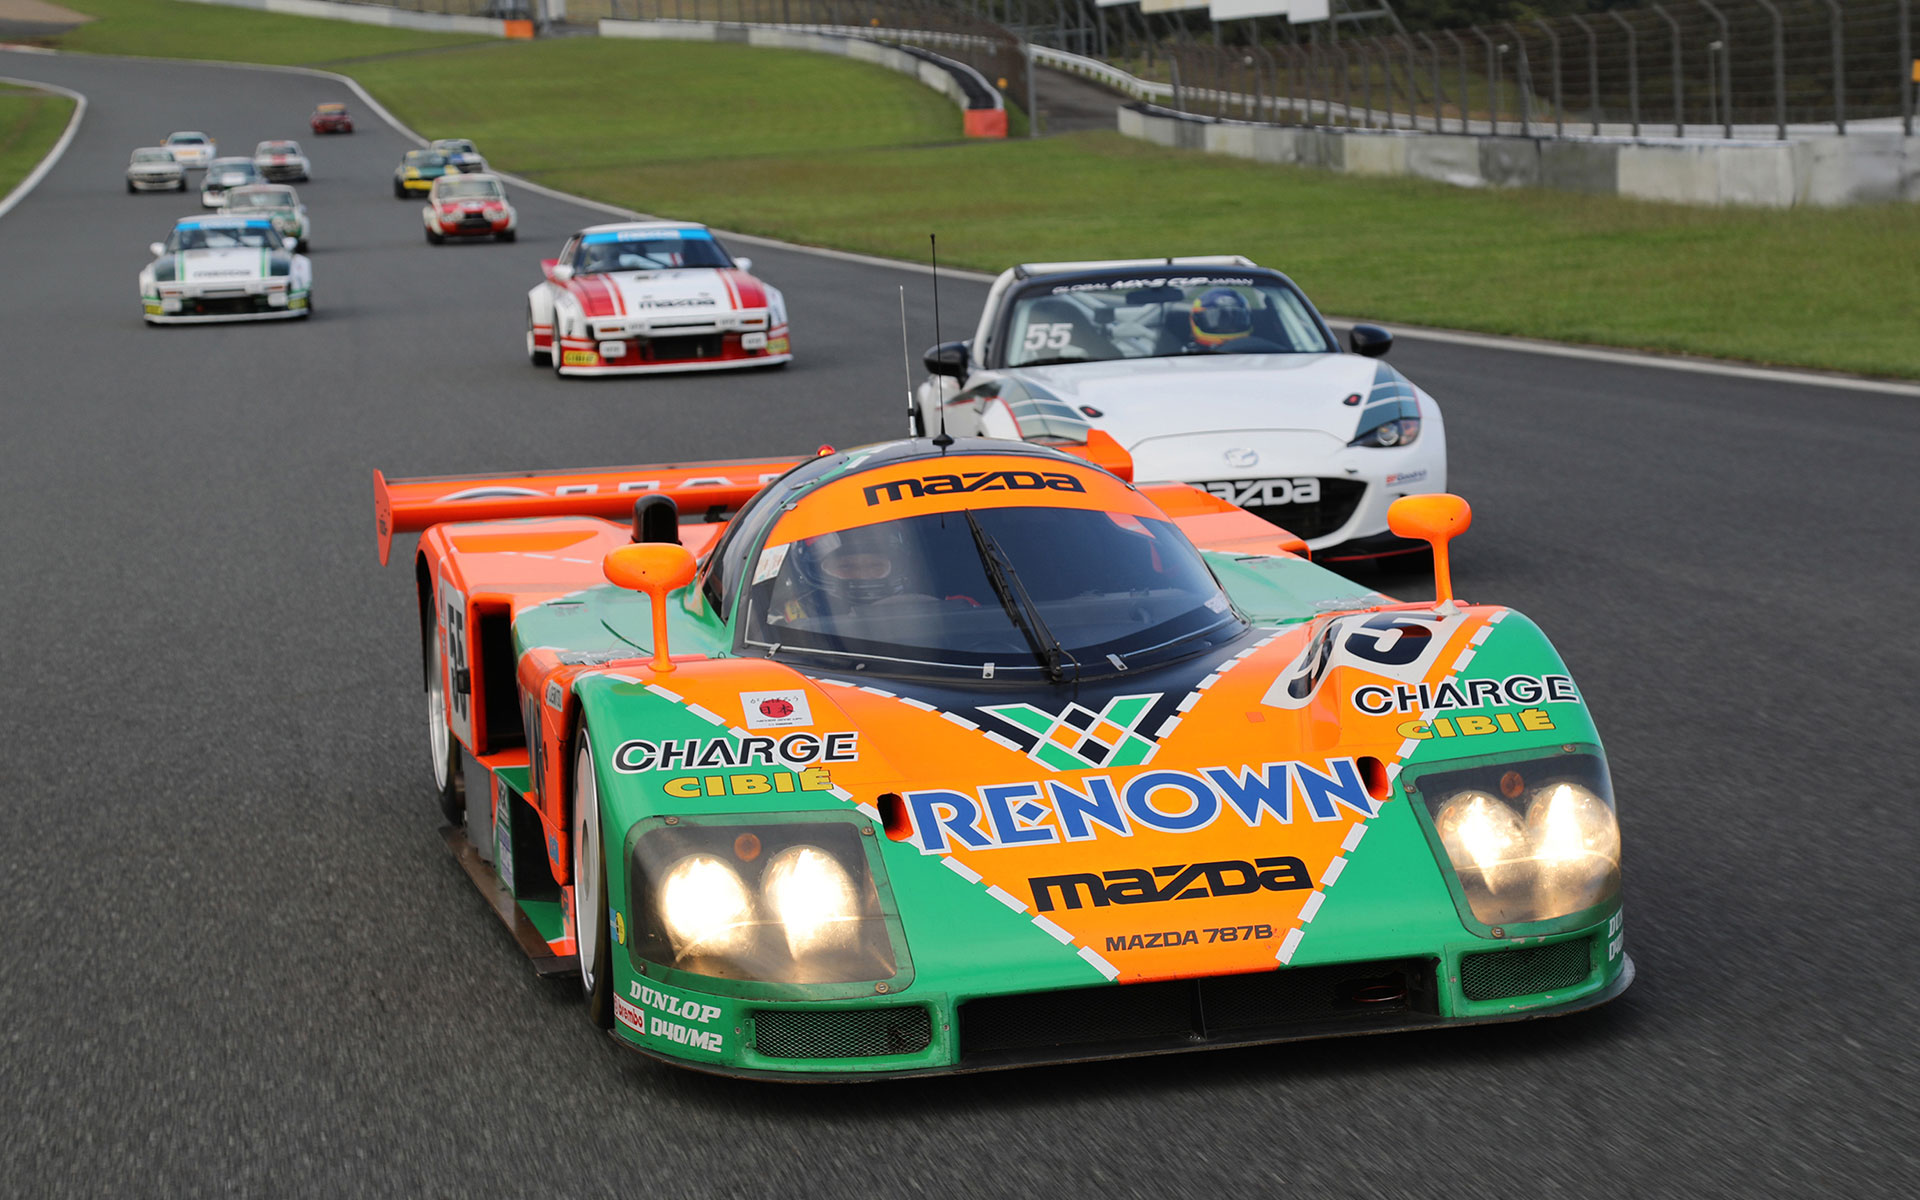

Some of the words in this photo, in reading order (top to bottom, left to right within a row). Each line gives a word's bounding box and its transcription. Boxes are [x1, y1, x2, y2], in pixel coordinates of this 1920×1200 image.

[1052, 283, 1109, 295] GLOBAL
[1110, 278, 1167, 289] MX-5
[1167, 277, 1209, 287] CUP
[1207, 278, 1254, 287] JAPAN
[1024, 323, 1074, 350] 55
[863, 471, 1088, 507] mazda
[1187, 477, 1321, 507] azda
[1351, 674, 1580, 717] CHARGE
[1396, 708, 1556, 740] CIBIÉ
[612, 731, 859, 774] CHARGE
[663, 767, 835, 798] CIBIÉ
[901, 757, 1379, 855] RENOWN
[1028, 856, 1315, 912] mazda
[1105, 930, 1199, 952] MAZDA
[1202, 924, 1274, 945] 787B
[617, 1001, 643, 1029] brembo
[629, 980, 722, 1024] DUNLOP
[650, 1017, 723, 1053] D40/M2
